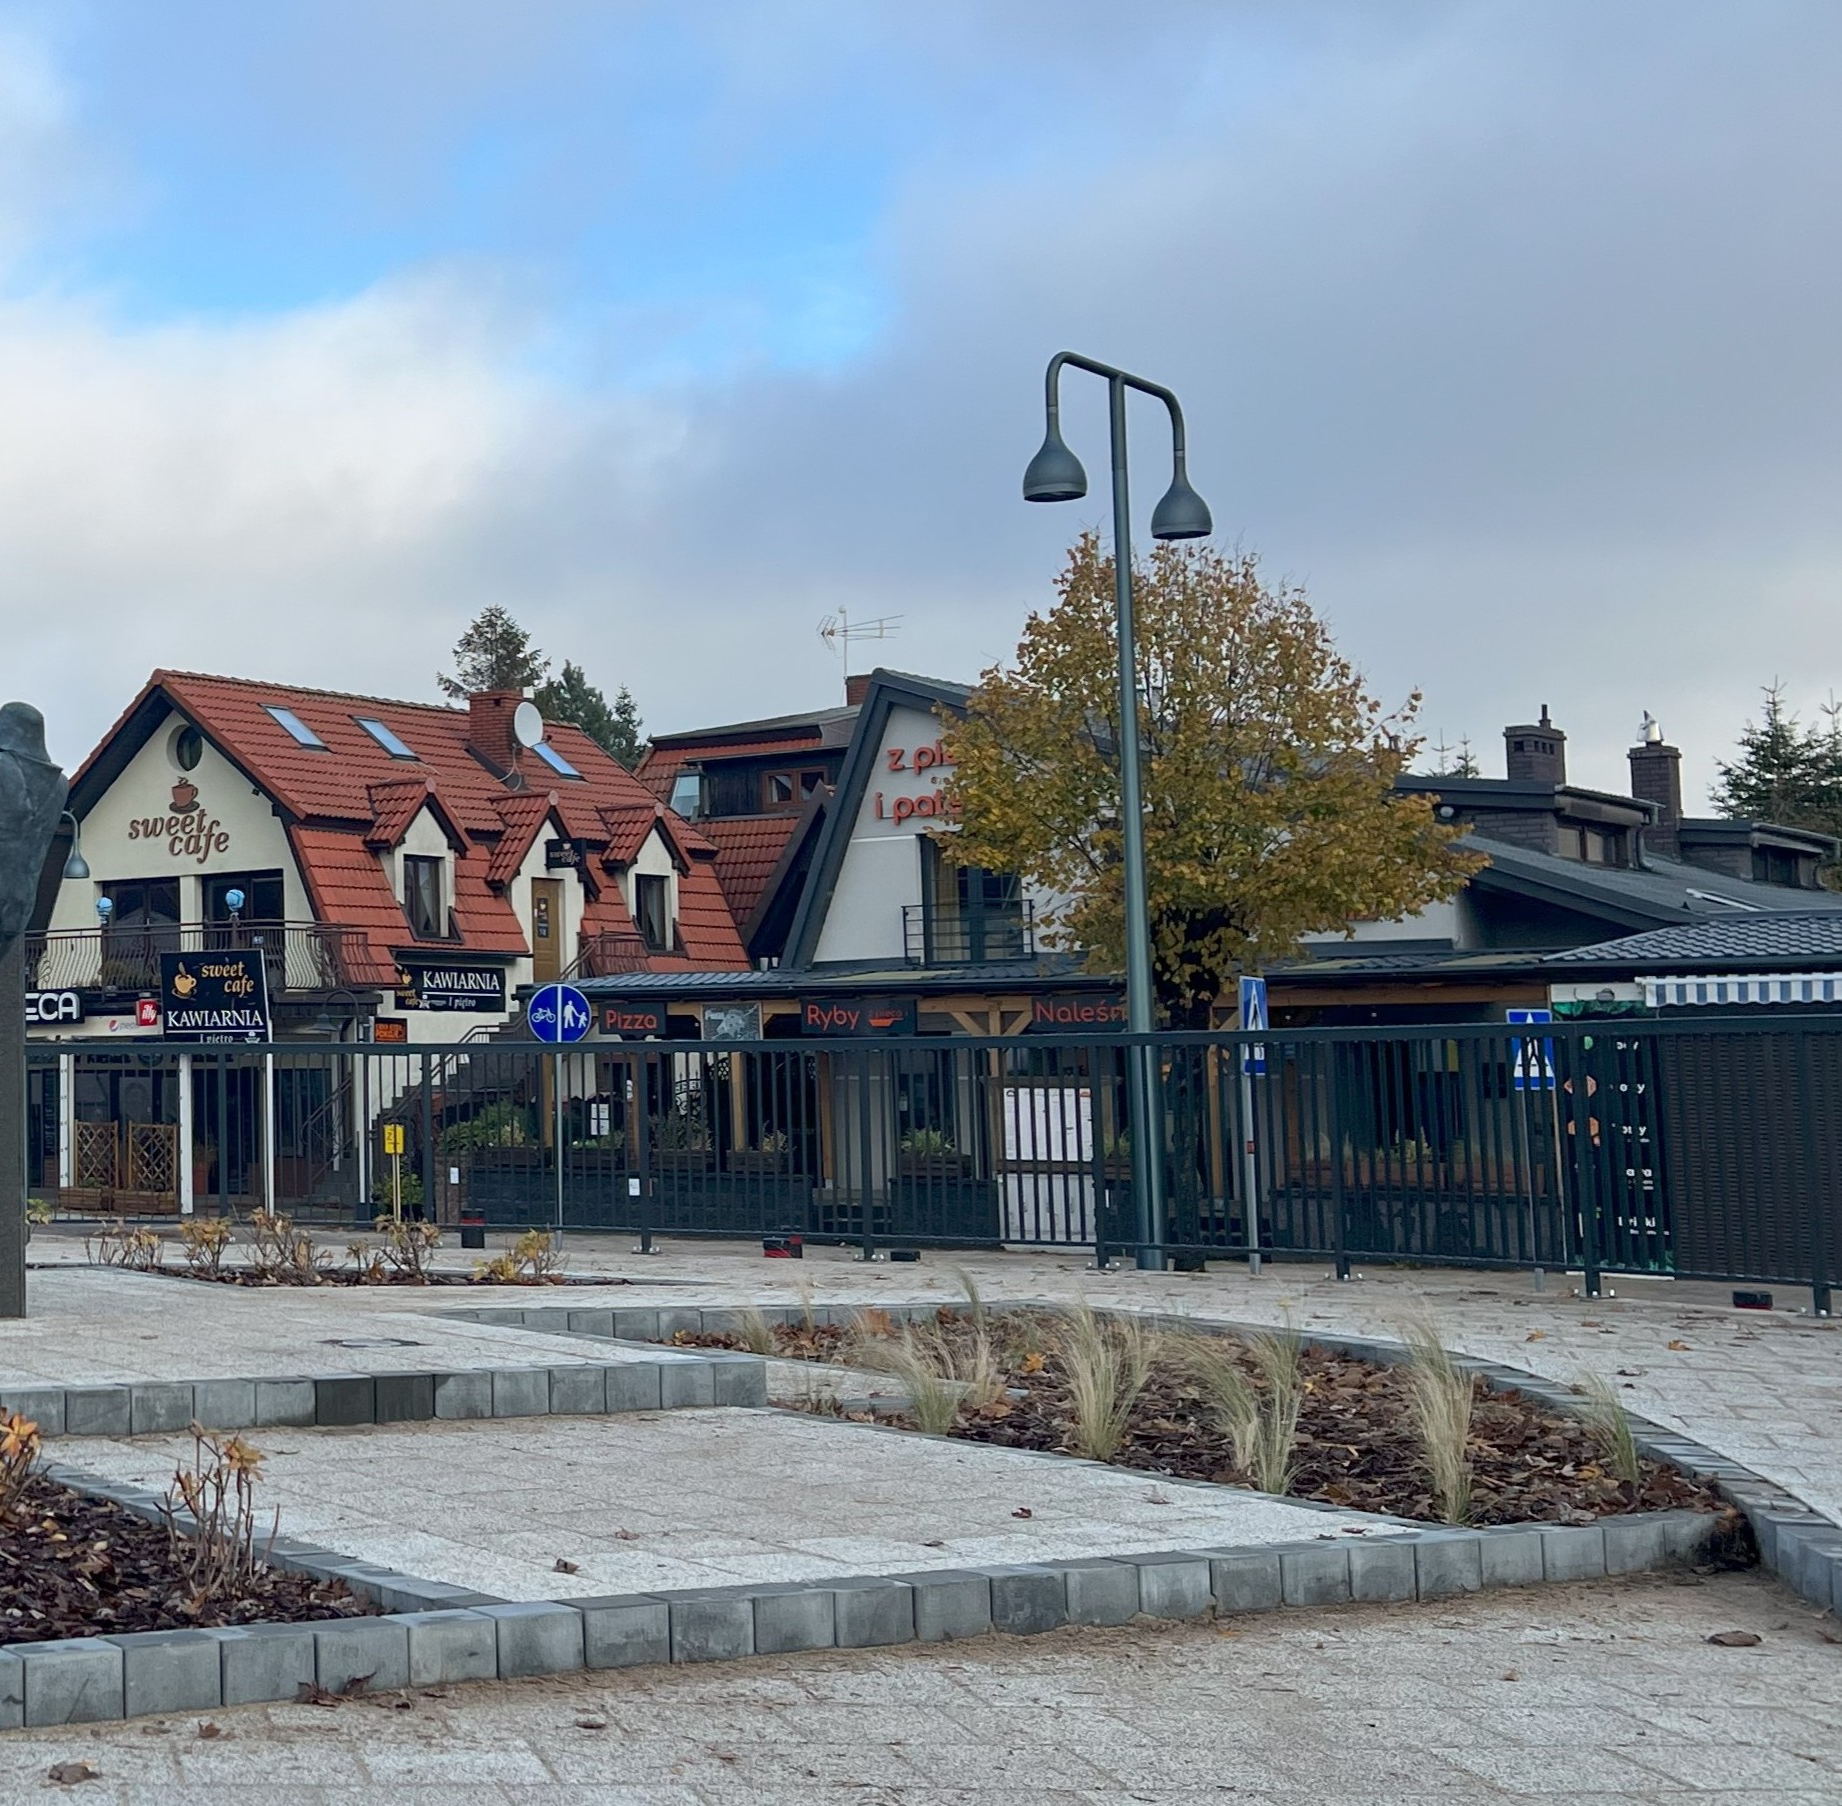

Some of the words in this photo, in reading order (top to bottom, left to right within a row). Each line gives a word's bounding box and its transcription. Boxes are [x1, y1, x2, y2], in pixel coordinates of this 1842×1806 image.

[887, 748, 905, 771] z
[875, 792, 883, 819] i
[128, 808, 207, 840] sweet
[169, 819, 230, 864] cafe
[201, 961, 245, 977] sweet
[422, 970, 500, 990] KAWIARNIA
[224, 974, 254, 998] cafe
[167, 1010, 264, 1027] KAWIARNIA
[605, 1009, 657, 1030] Pizza
[807, 1003, 860, 1031] Ryby
